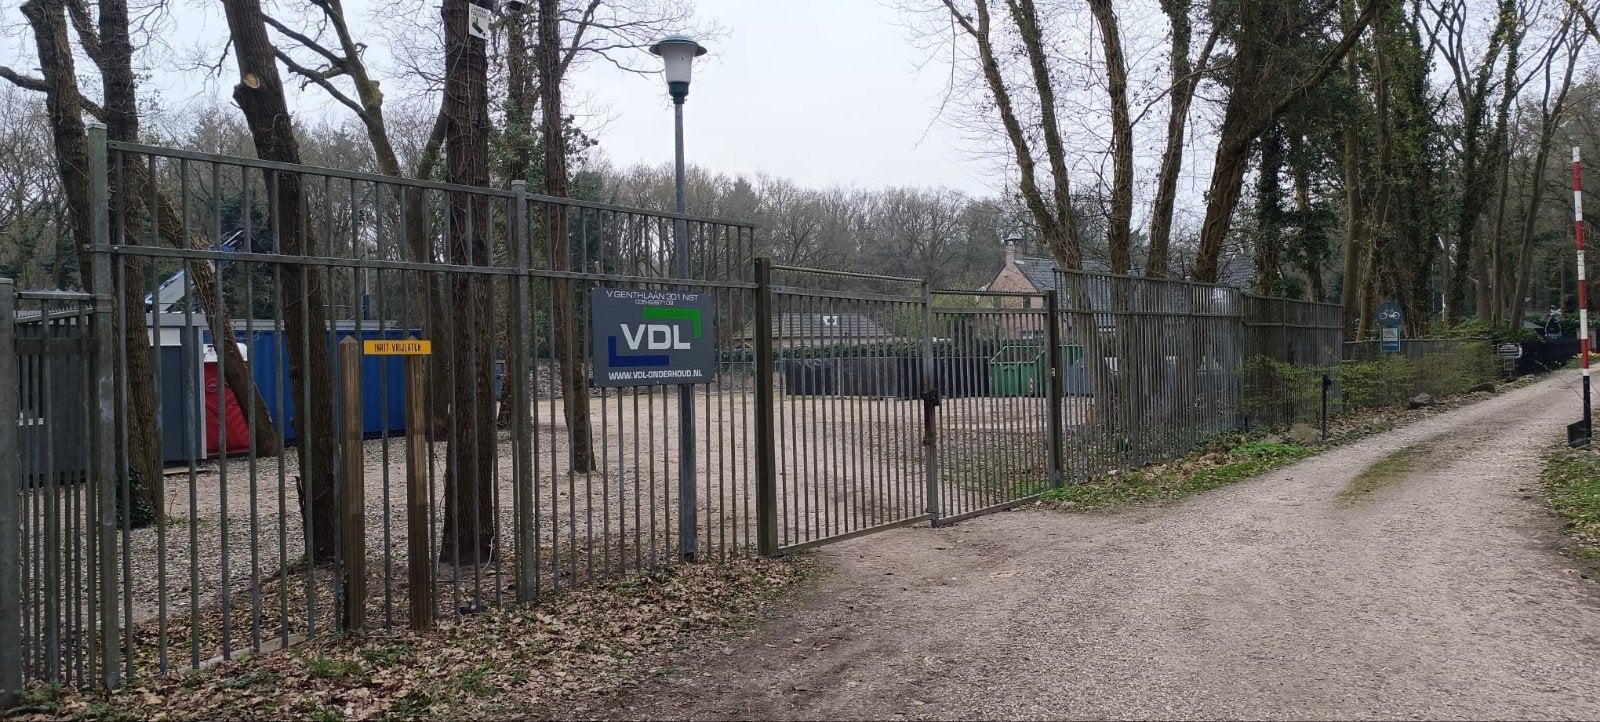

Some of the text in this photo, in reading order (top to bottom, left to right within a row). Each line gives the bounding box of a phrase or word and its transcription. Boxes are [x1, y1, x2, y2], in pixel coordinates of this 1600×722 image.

[620, 323, 691, 350] VDL
[374, 343, 389, 352] INRIT
[608, 369, 703, 380] WWW.VDL-ONDERHOUD.NL
